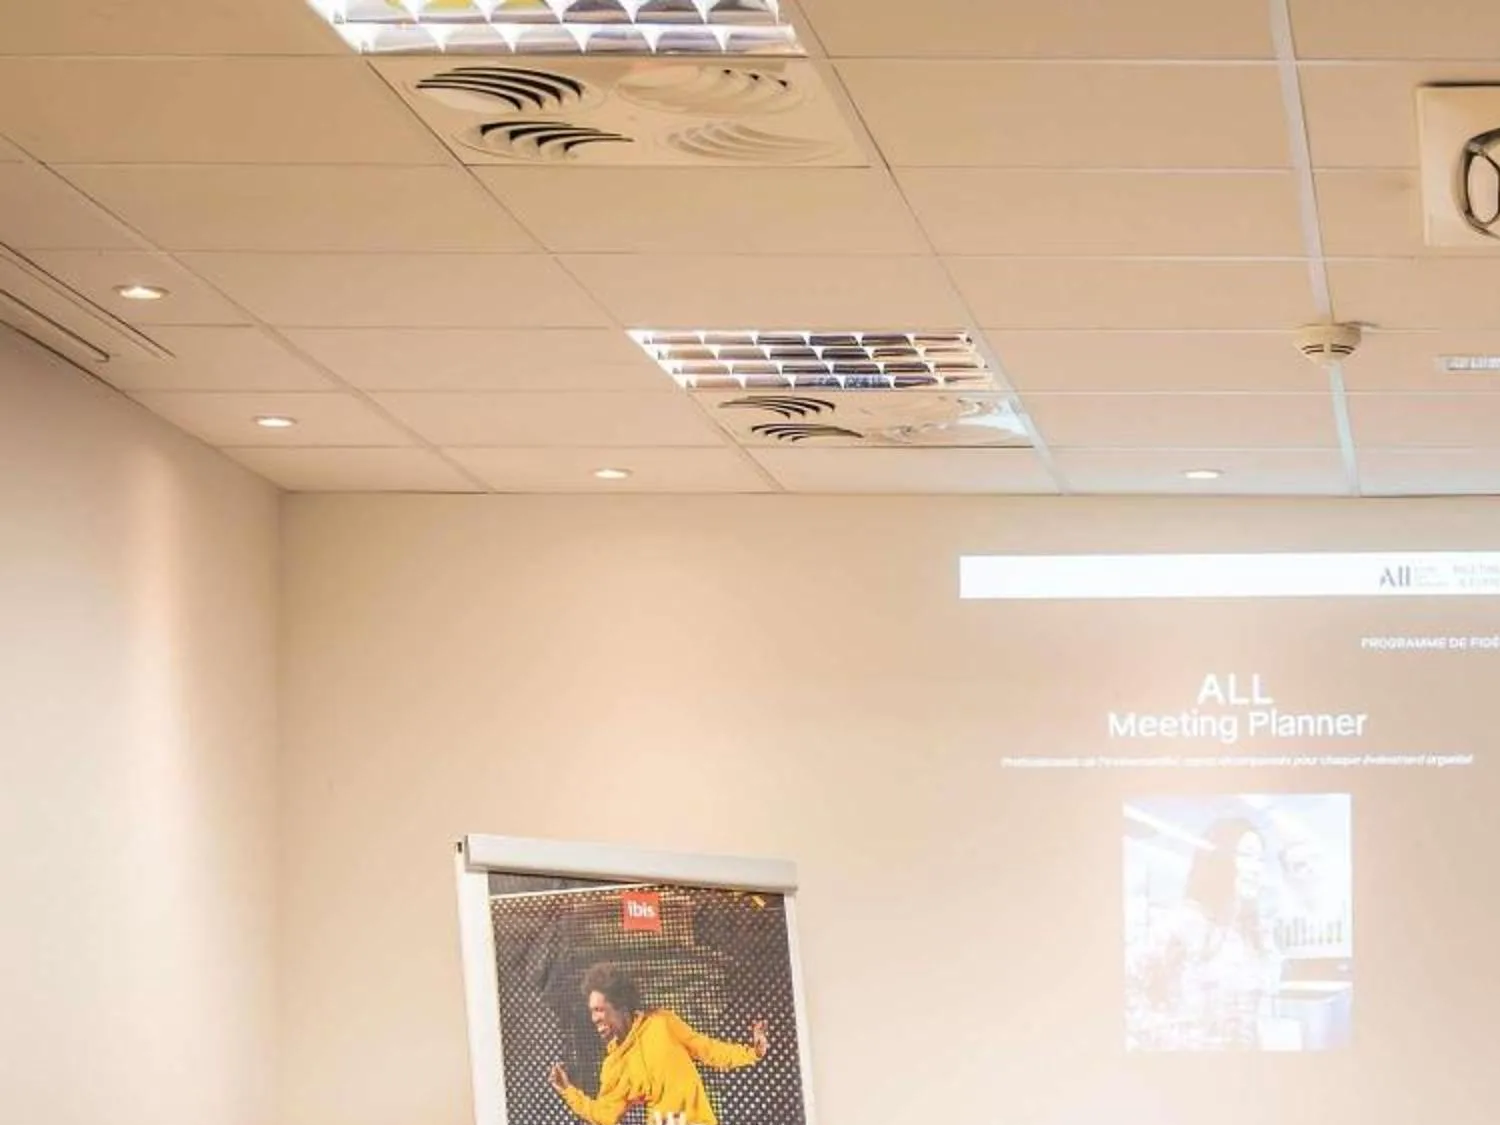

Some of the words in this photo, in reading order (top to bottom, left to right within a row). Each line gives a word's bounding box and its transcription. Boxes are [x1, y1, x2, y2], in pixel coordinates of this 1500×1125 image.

[1379, 564, 1412, 588] All
[1361, 637, 1446, 650] PROGRAMME
[1449, 636, 1468, 649] DE
[1196, 673, 1276, 706] ALL
[1108, 710, 1239, 744] Meeting
[1248, 710, 1368, 738] Planner
[628, 902, 655, 917] ibis
